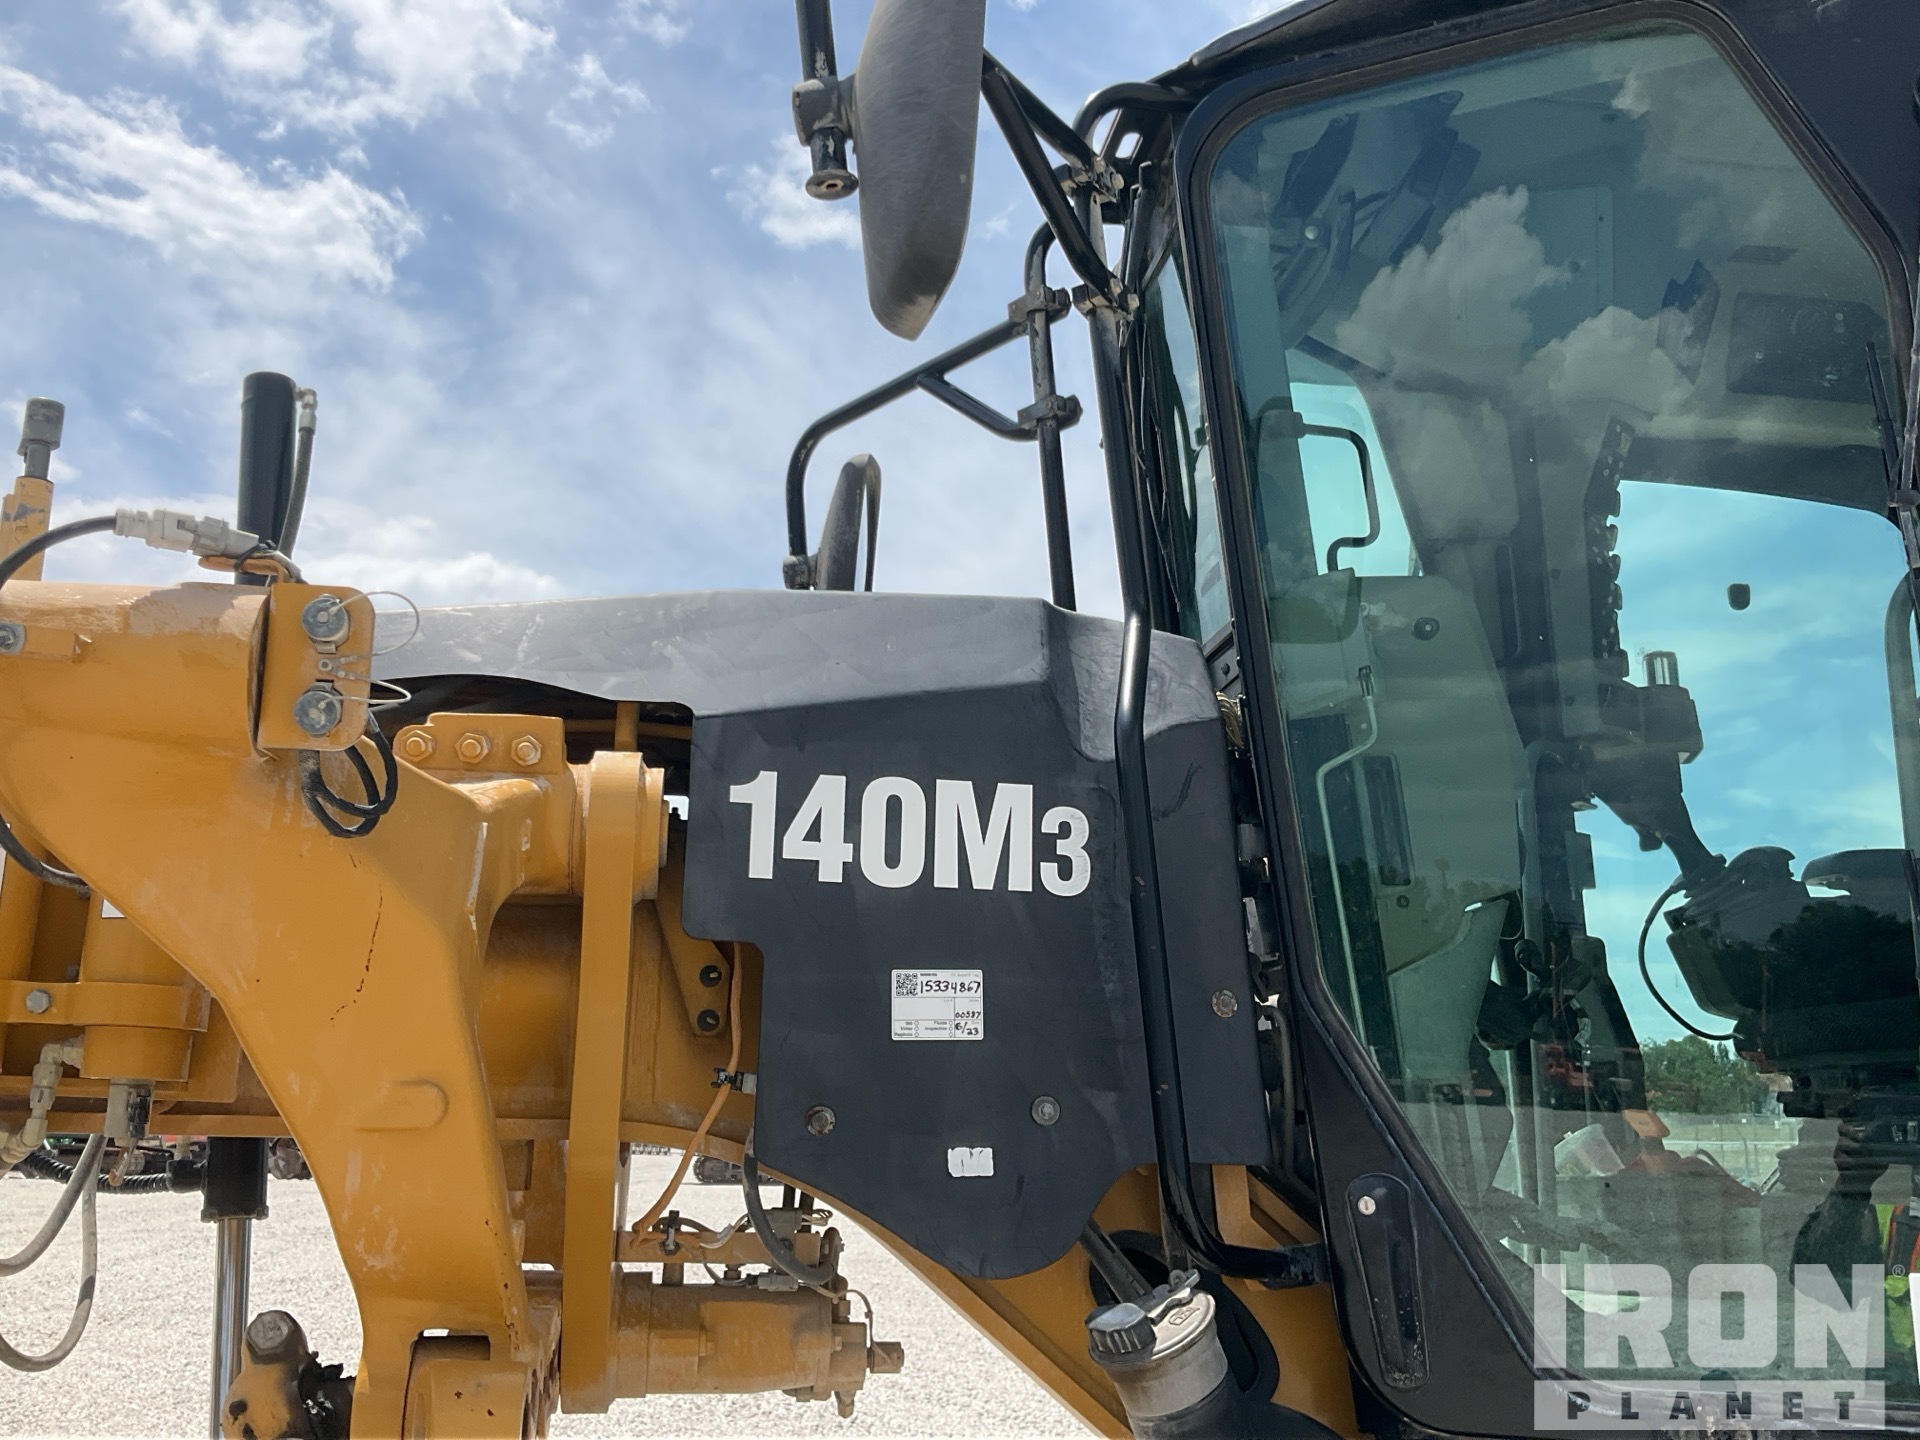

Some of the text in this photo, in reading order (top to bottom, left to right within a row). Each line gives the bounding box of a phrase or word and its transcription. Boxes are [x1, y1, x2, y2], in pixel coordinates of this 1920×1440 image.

[729, 770, 1092, 897] 140M3
[921, 980, 981, 994] 15334867
[955, 1021, 979, 1036] 6/23
